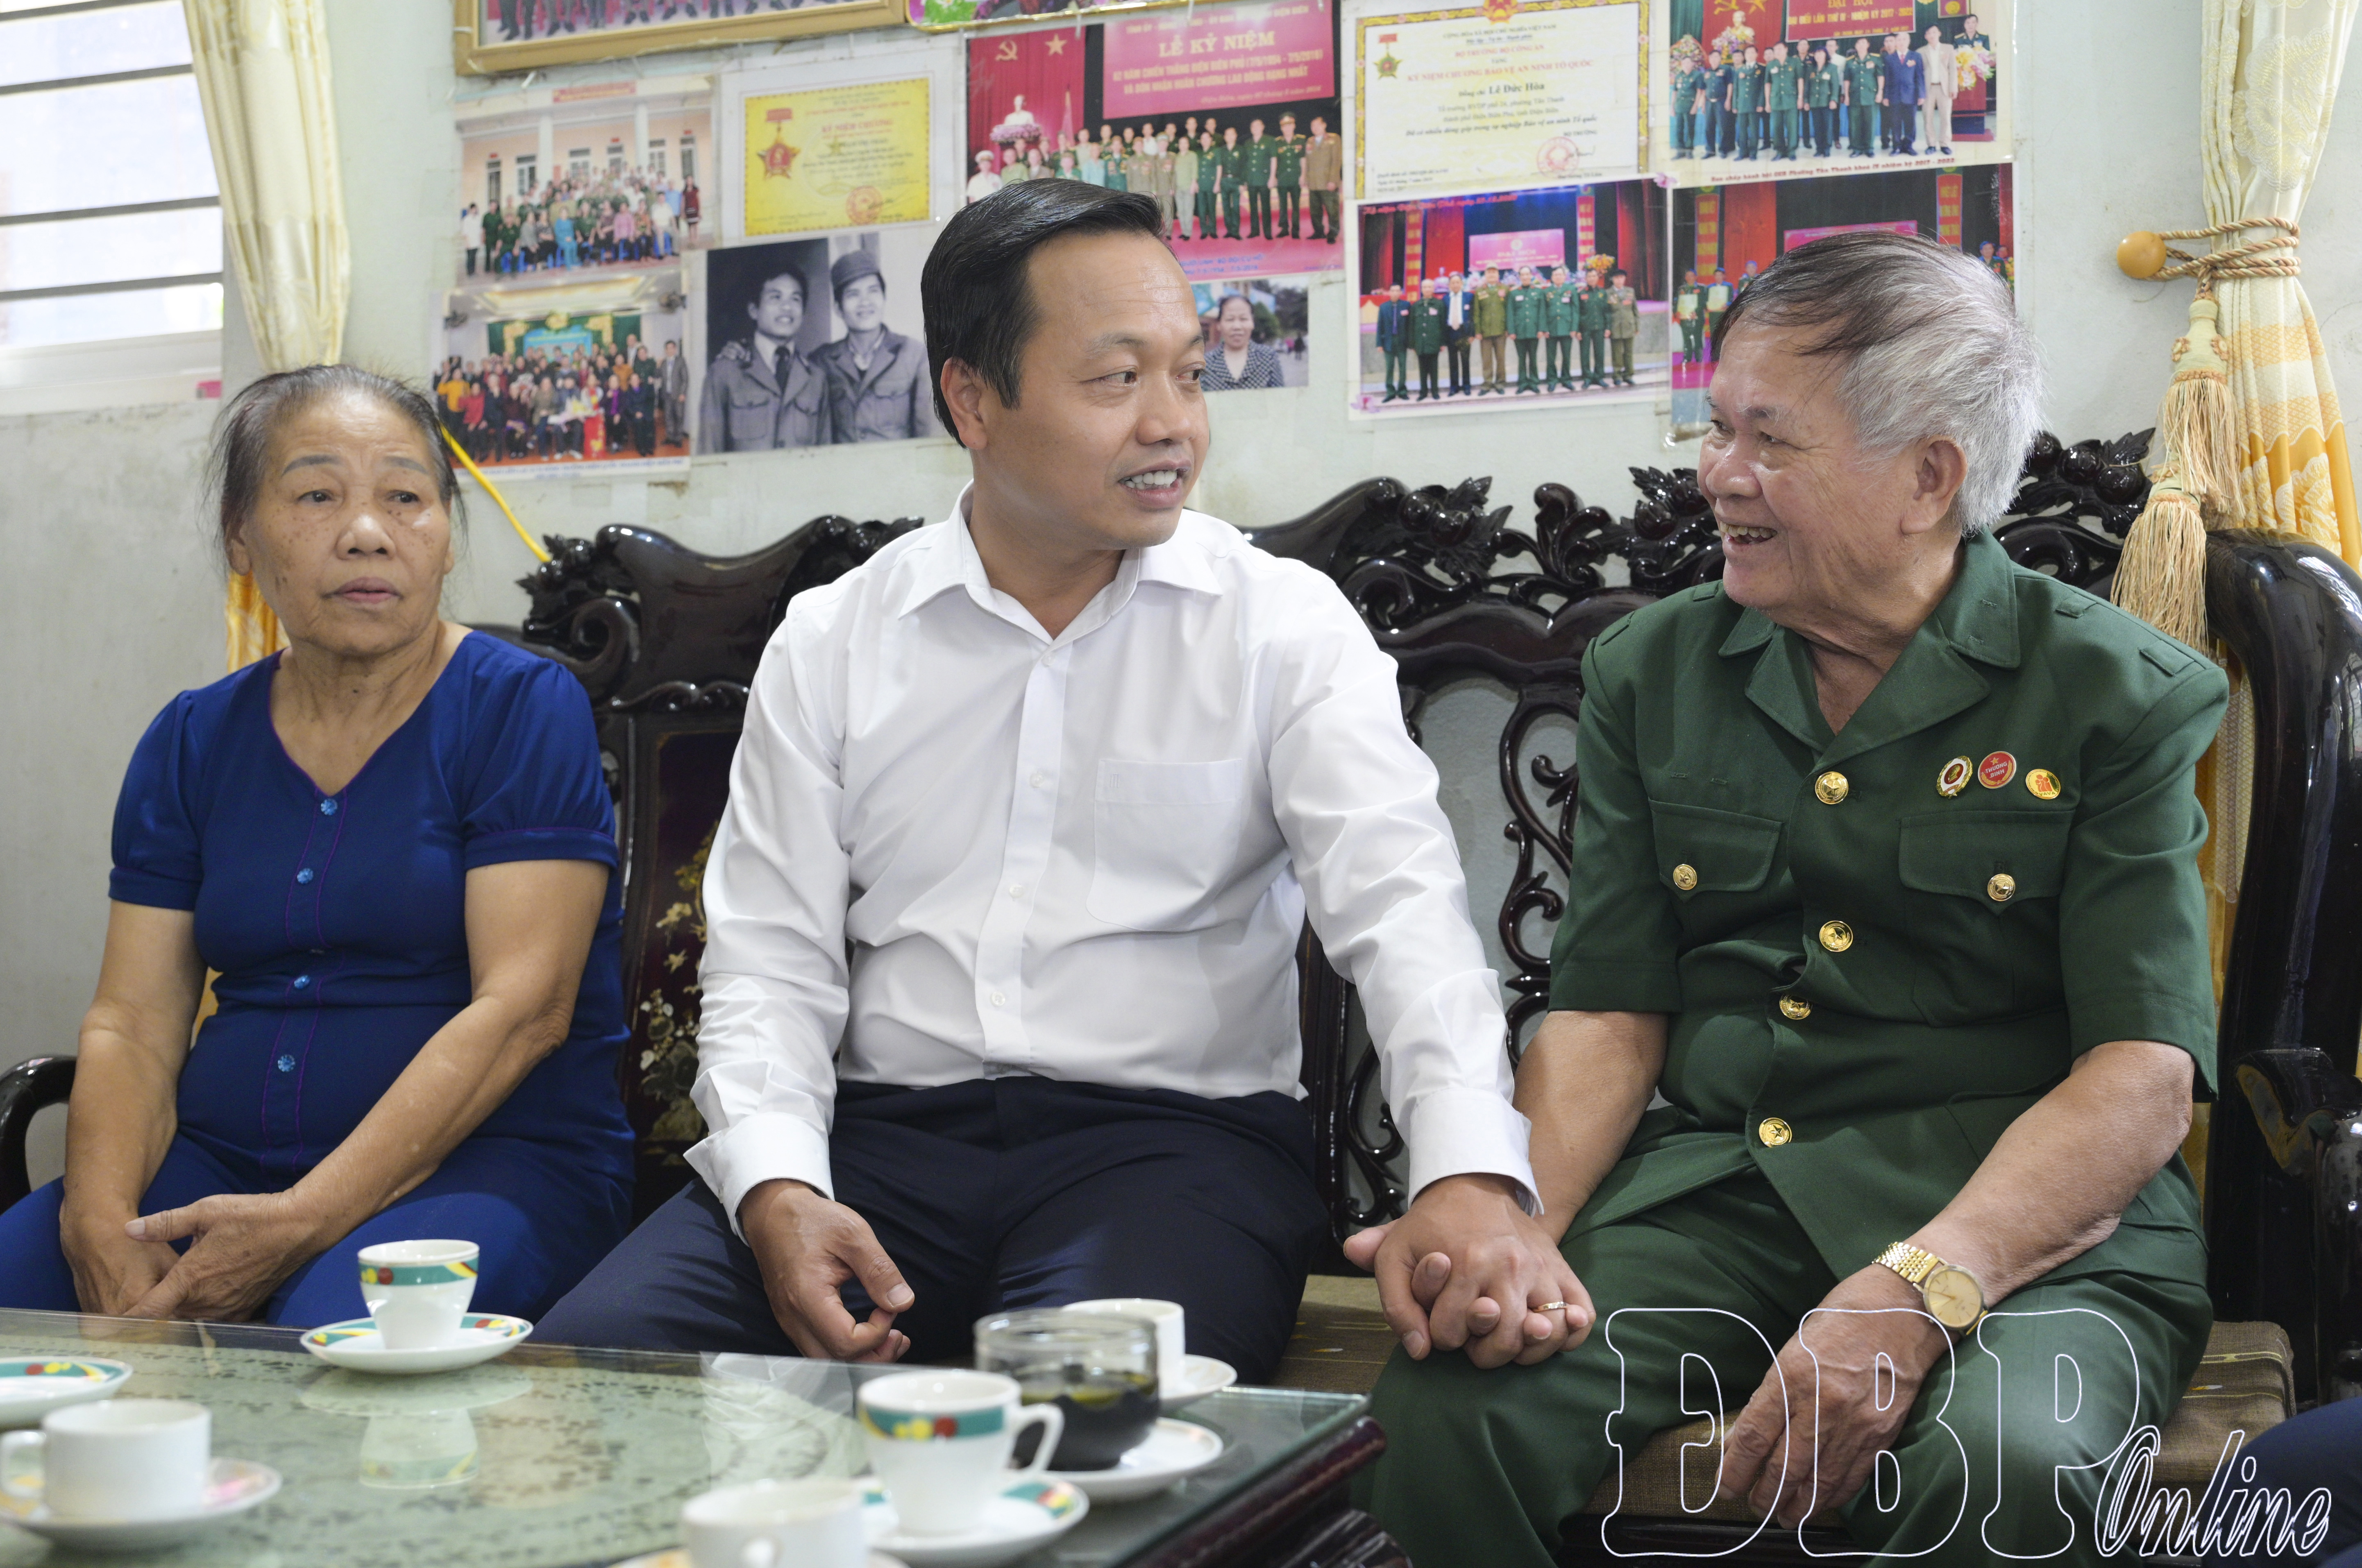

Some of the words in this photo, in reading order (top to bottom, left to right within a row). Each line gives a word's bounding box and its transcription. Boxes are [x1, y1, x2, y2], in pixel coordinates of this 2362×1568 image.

[1159, 34, 1183, 57] LỄ
[1190, 32, 1217, 54] KỶ
[1223, 30, 1275, 51] NIỆM
[1488, 84, 1501, 95] Lê
[1990, 768, 2005, 778] BINH
